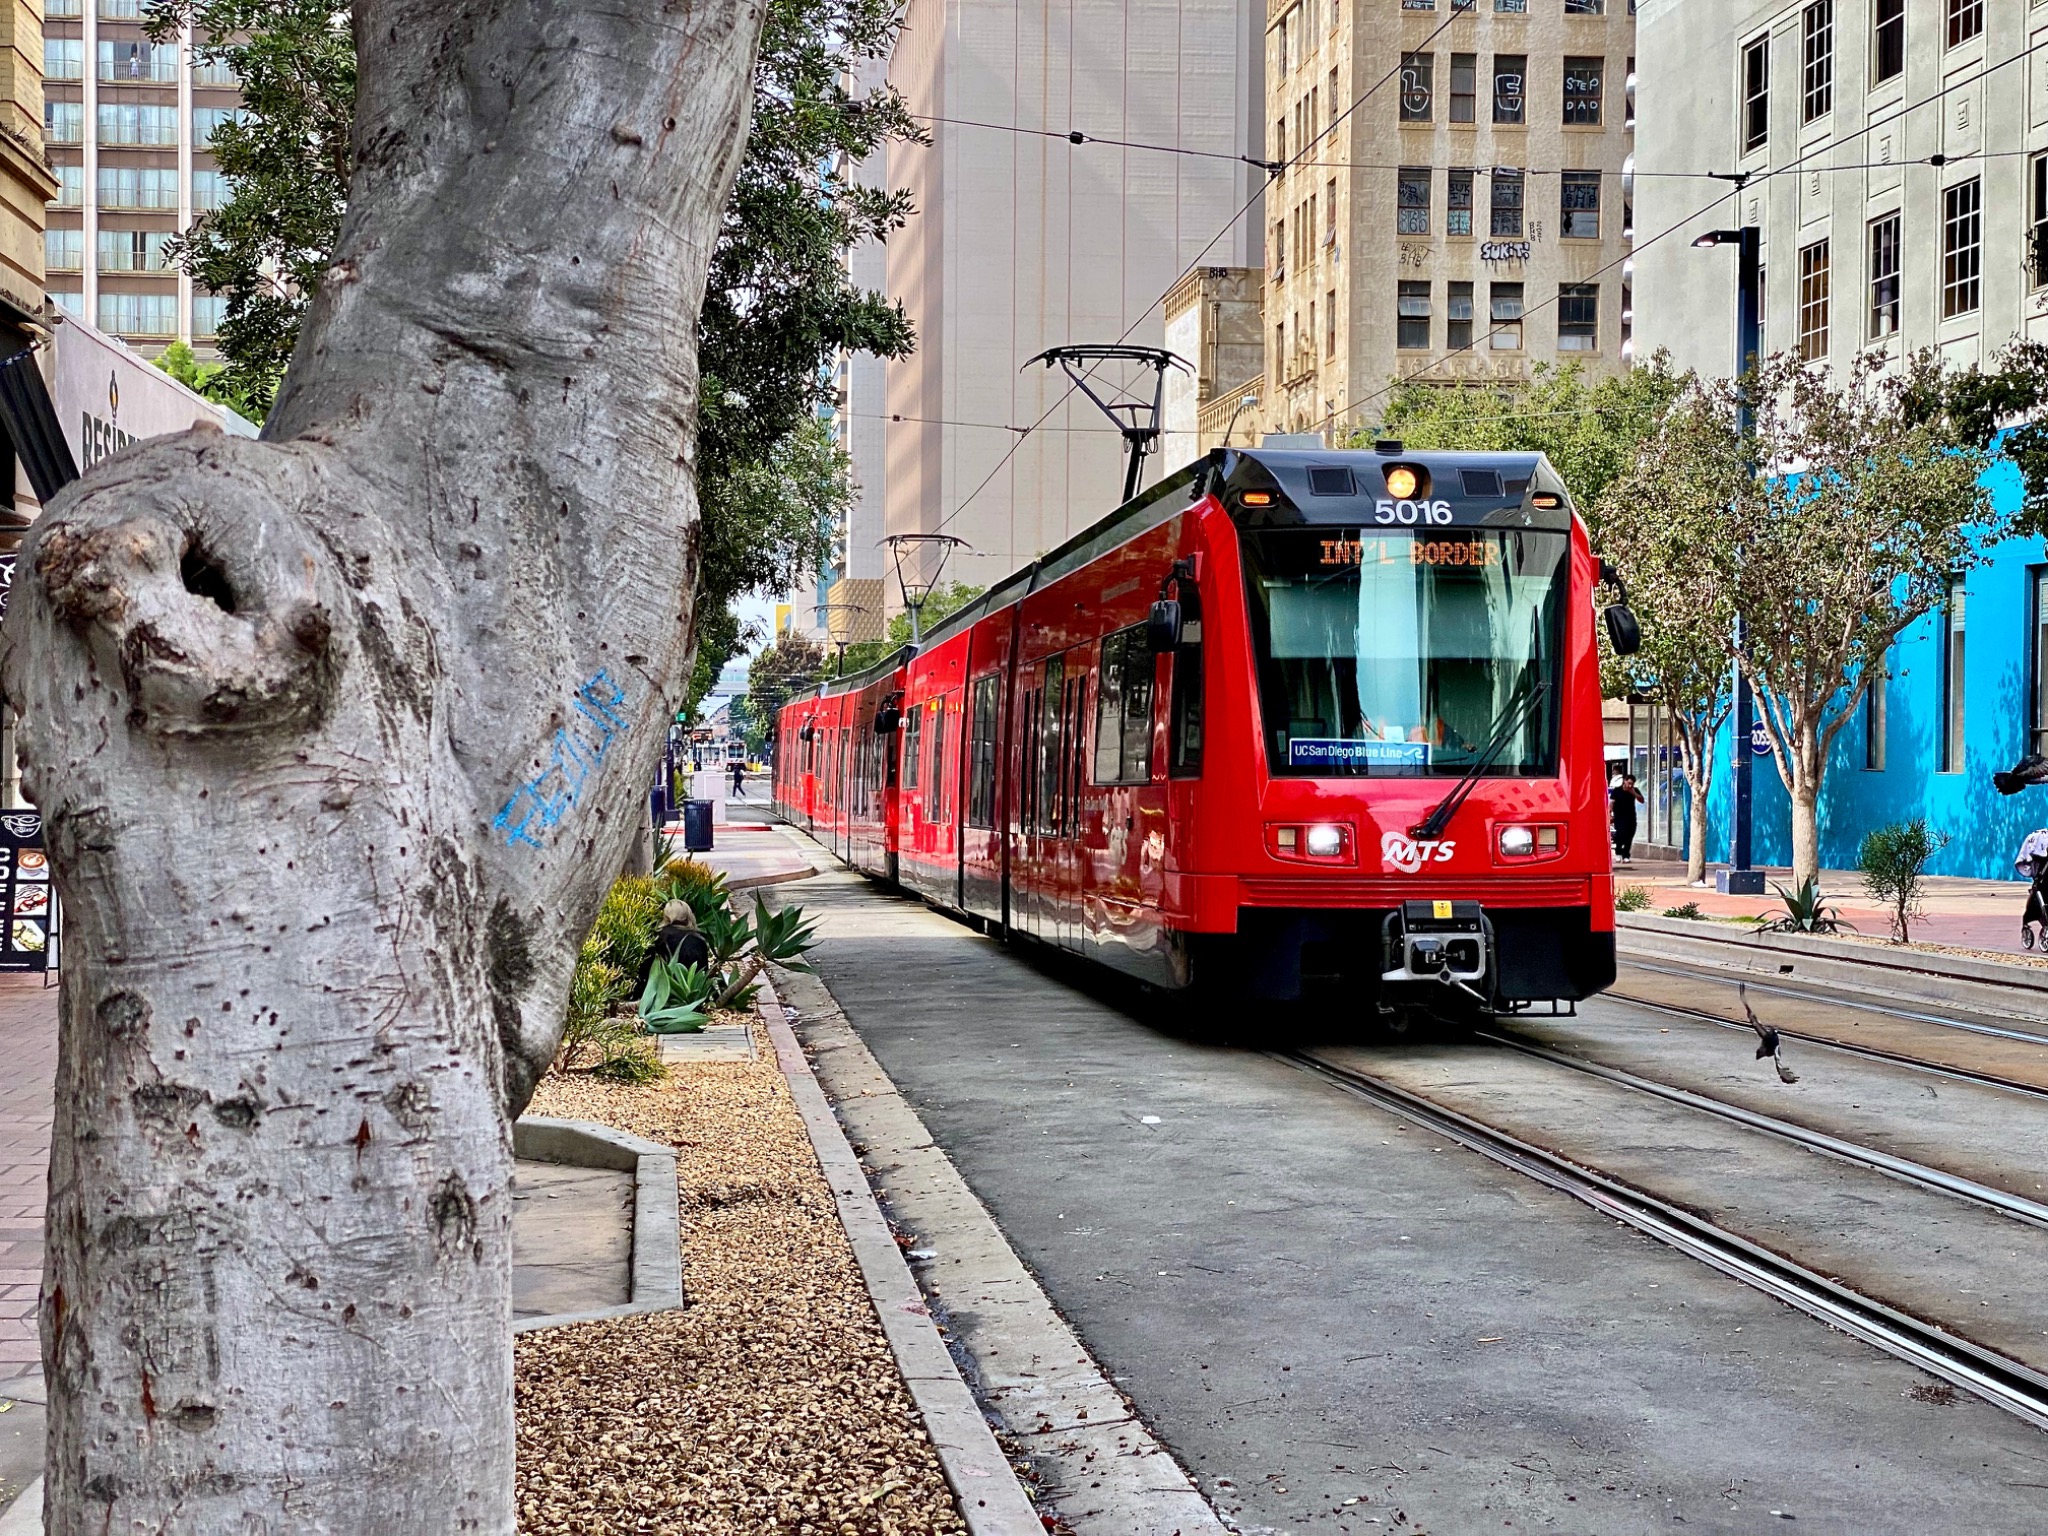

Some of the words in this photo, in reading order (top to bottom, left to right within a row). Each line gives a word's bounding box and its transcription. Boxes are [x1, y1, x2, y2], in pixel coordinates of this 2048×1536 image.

[1566, 77, 1599, 91] STEP
[1566, 100, 1599, 111] DAD
[1374, 499, 1453, 525] 5016
[1319, 540, 1395, 565] INT'L
[1409, 541, 1499, 566] BORDER
[1294, 744, 1309, 756] UC
[1309, 744, 1328, 757] San
[1328, 745, 1355, 759] Diego
[1355, 746, 1379, 758] Blue
[1381, 746, 1403, 759] Line
[1382, 840, 1457, 862] MTS
